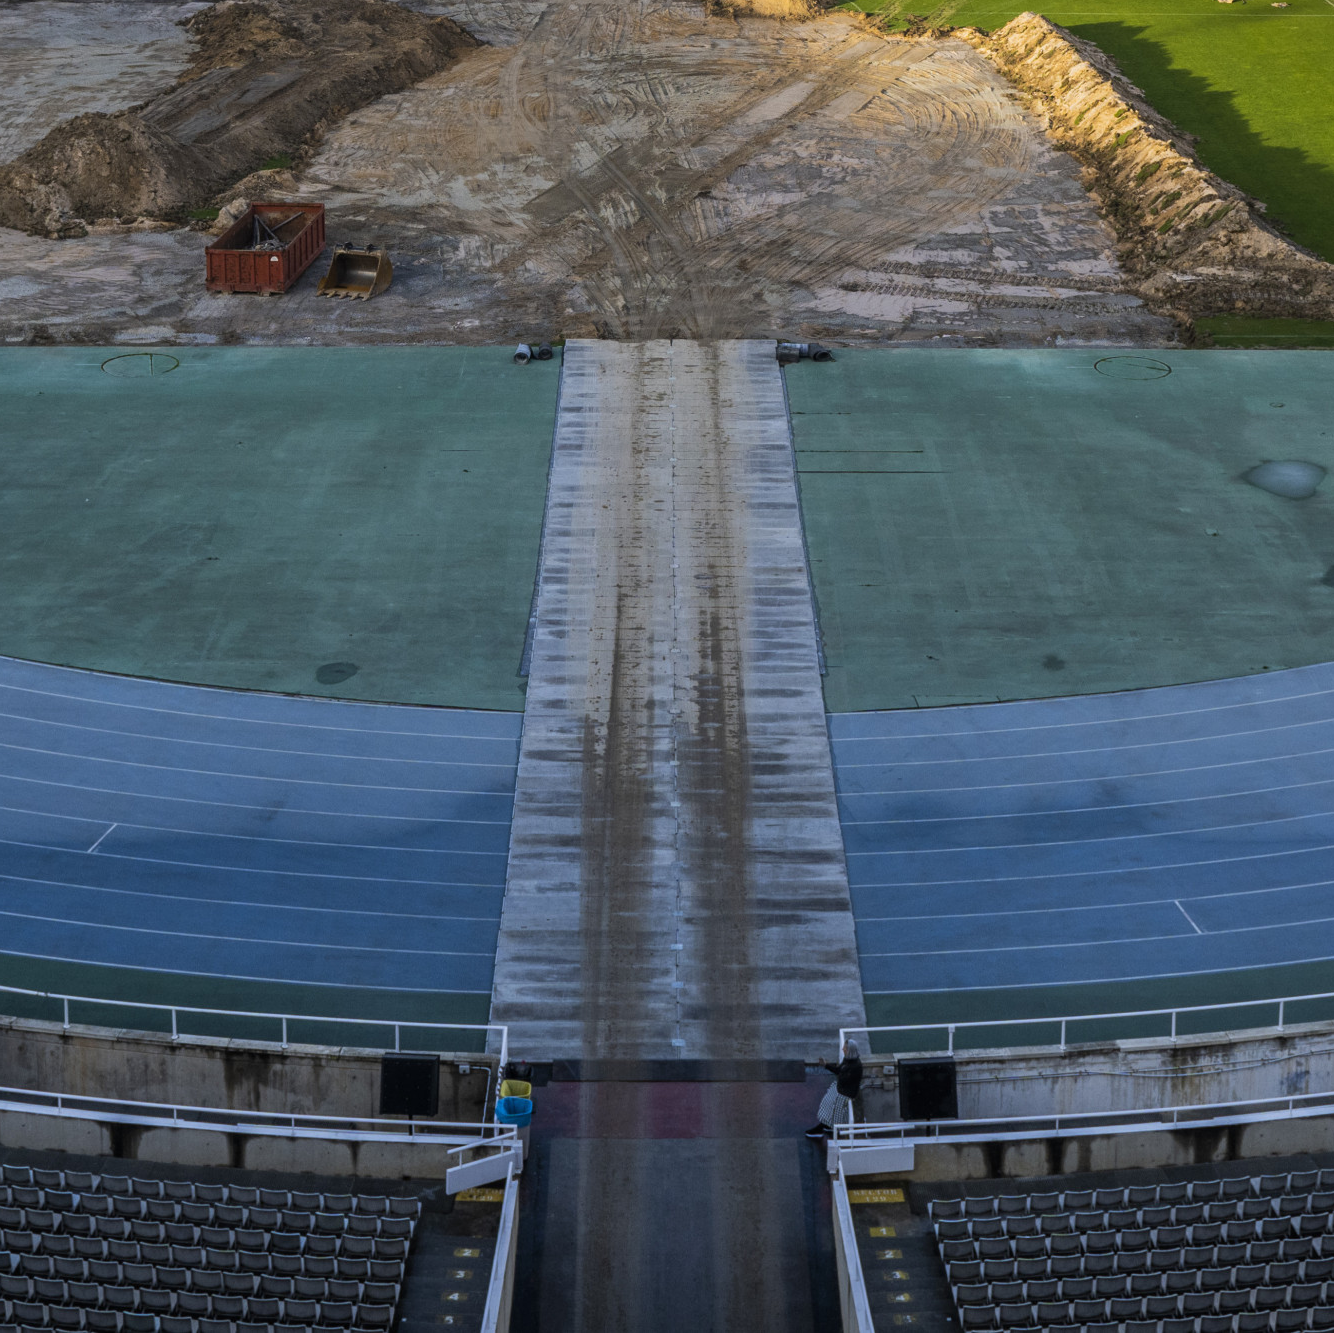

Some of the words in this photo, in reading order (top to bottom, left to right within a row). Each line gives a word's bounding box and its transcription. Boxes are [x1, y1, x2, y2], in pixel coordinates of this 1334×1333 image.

[462, 1249, 472, 1257] 2
[884, 1250, 894, 1259] 2
[455, 1270, 466, 1279] 3
[449, 1292, 460, 1301] 4
